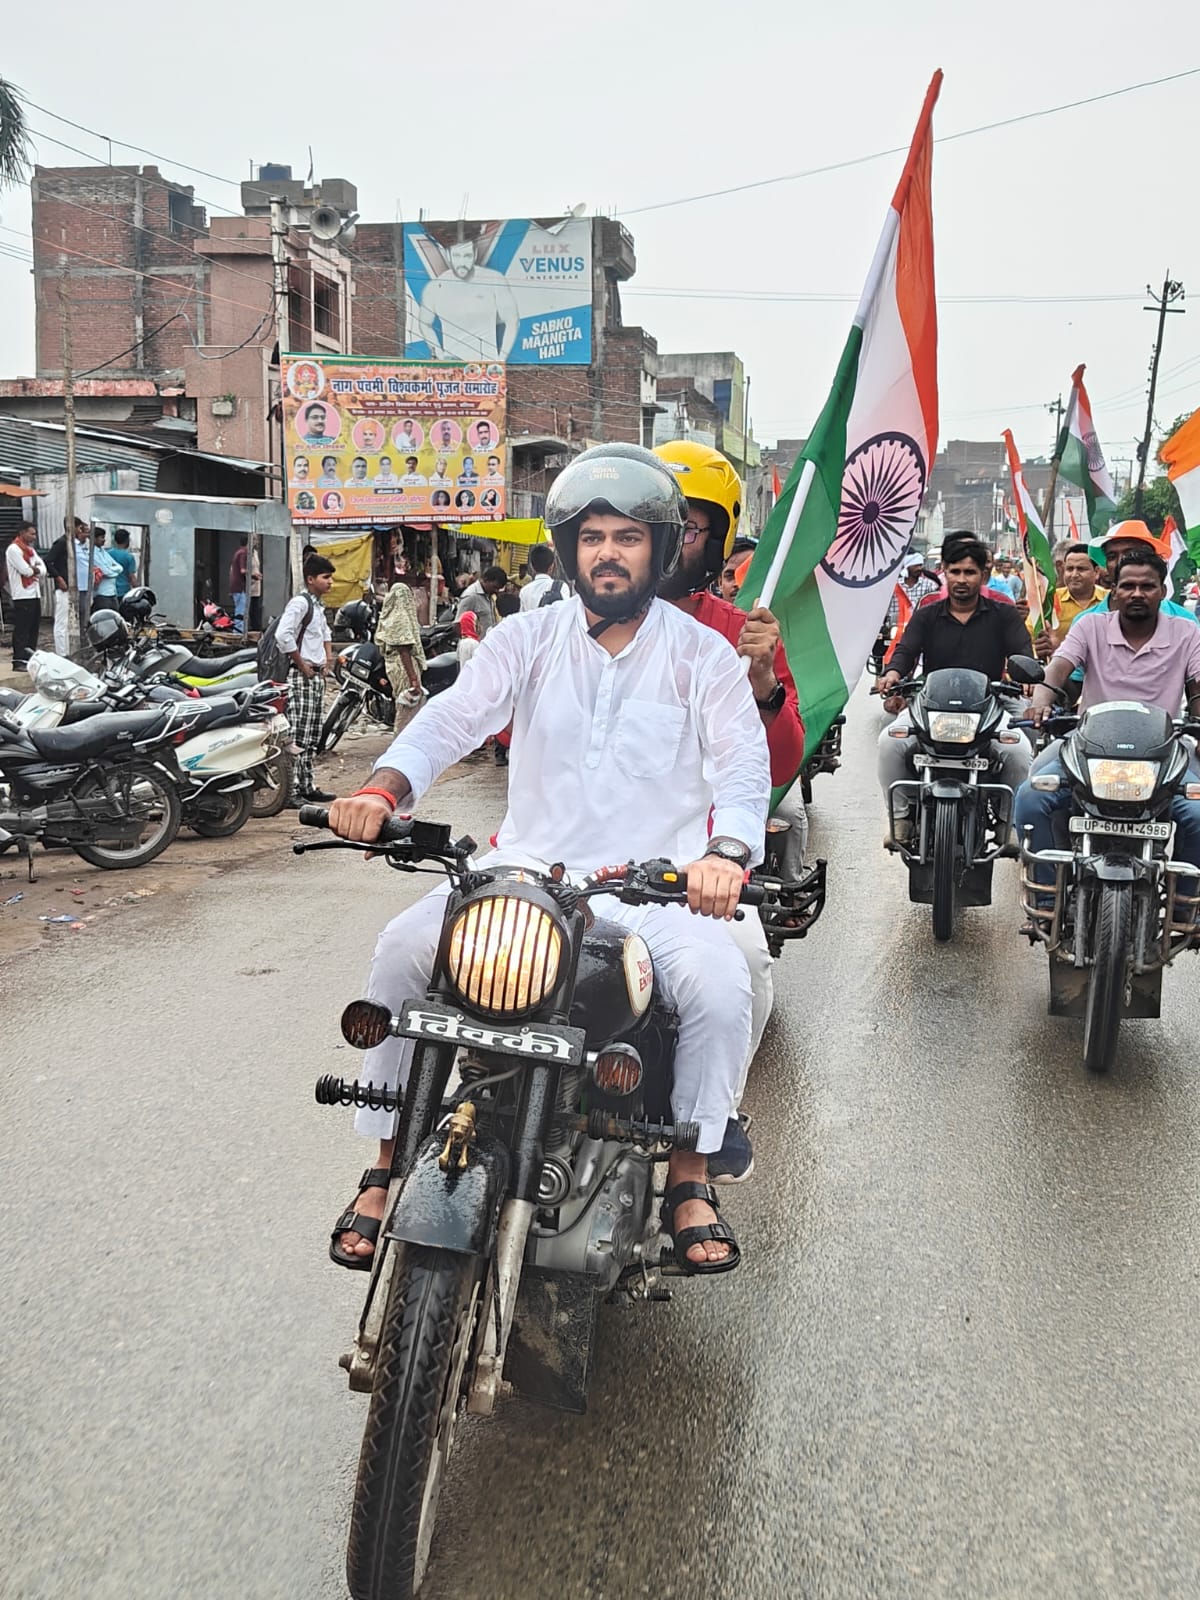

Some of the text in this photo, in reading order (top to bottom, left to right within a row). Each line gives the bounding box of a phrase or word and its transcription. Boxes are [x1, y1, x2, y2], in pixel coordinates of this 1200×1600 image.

[532, 244, 570, 254] LUX
[519, 256, 585, 273] VENUS
[531, 316, 573, 335] SABKO
[522, 327, 582, 350] MAANGTA
[539, 343, 565, 359] HAI!
[332, 376, 498, 397] नाग पंचमी विश्वकर्मा पूजन समारोह
